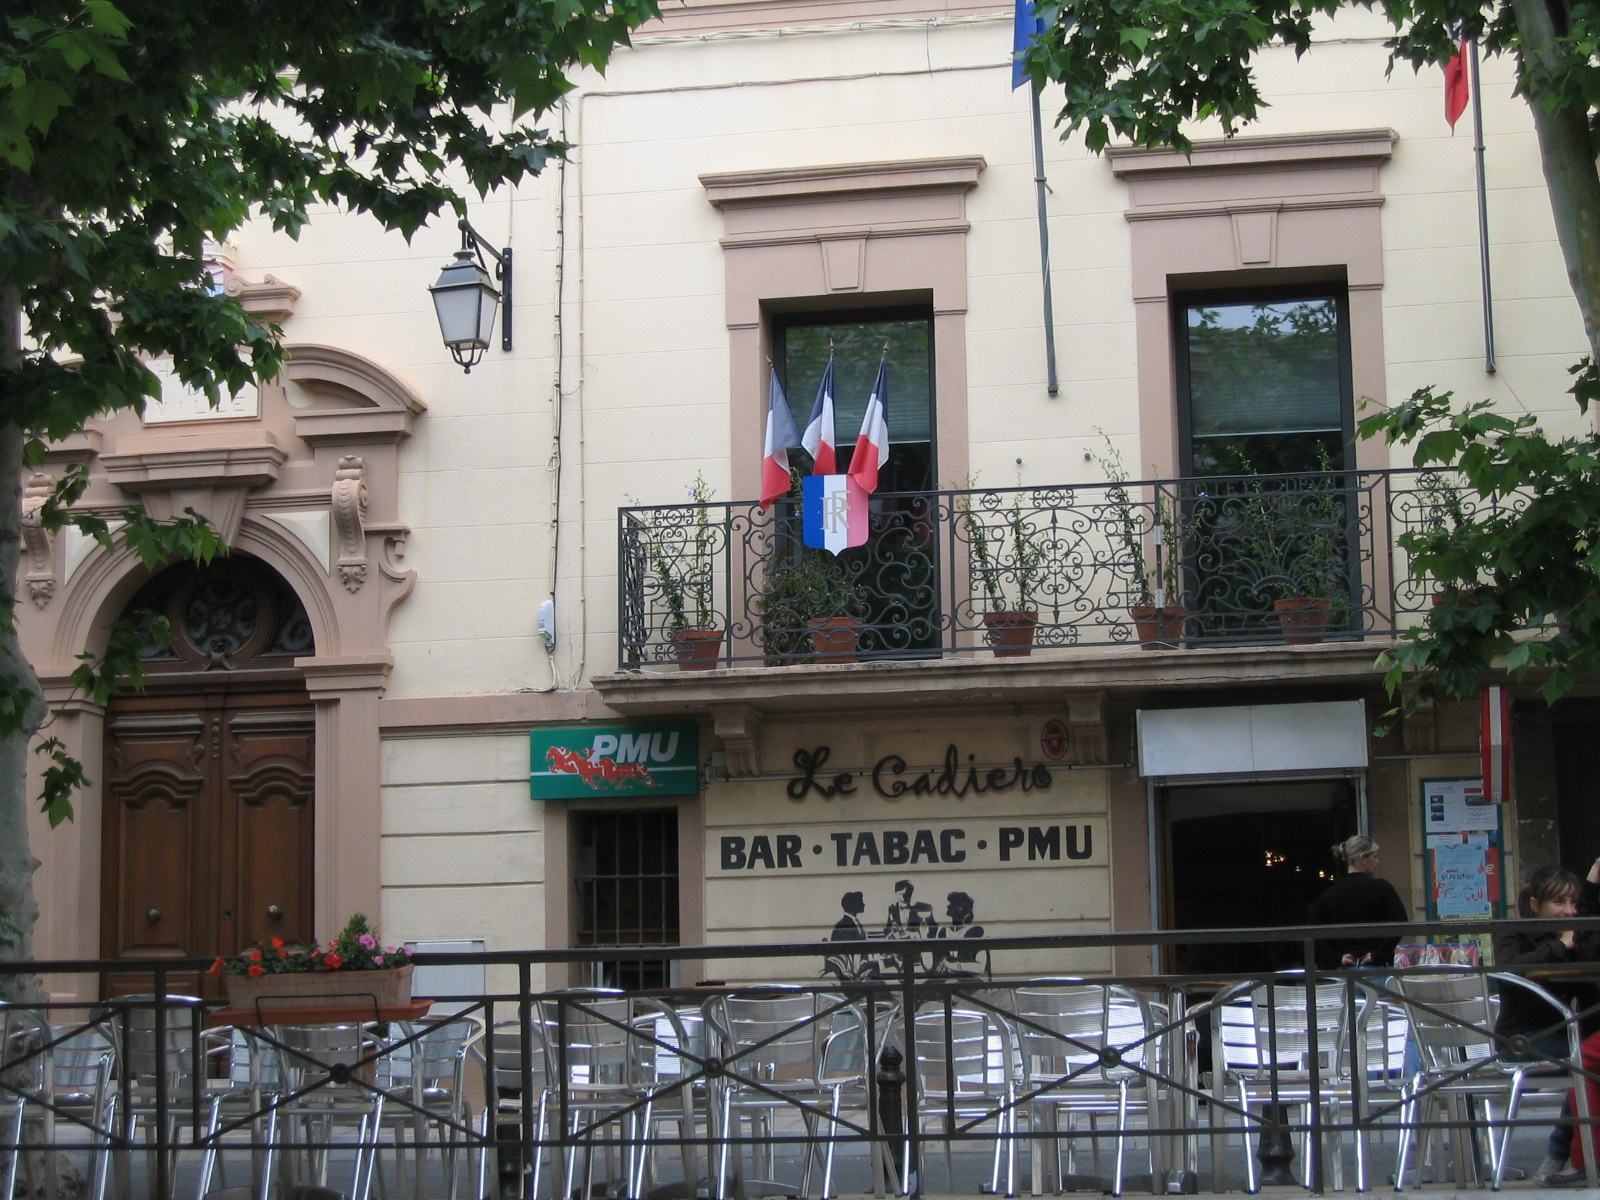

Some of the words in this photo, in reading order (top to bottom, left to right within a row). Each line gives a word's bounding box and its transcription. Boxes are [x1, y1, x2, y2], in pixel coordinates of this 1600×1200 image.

[588, 731, 680, 764] PMU
[787, 746, 857, 800] Le
[720, 834, 803, 870] BAR
[830, 828, 967, 867] TABAC
[998, 824, 1093, 862] PMU
